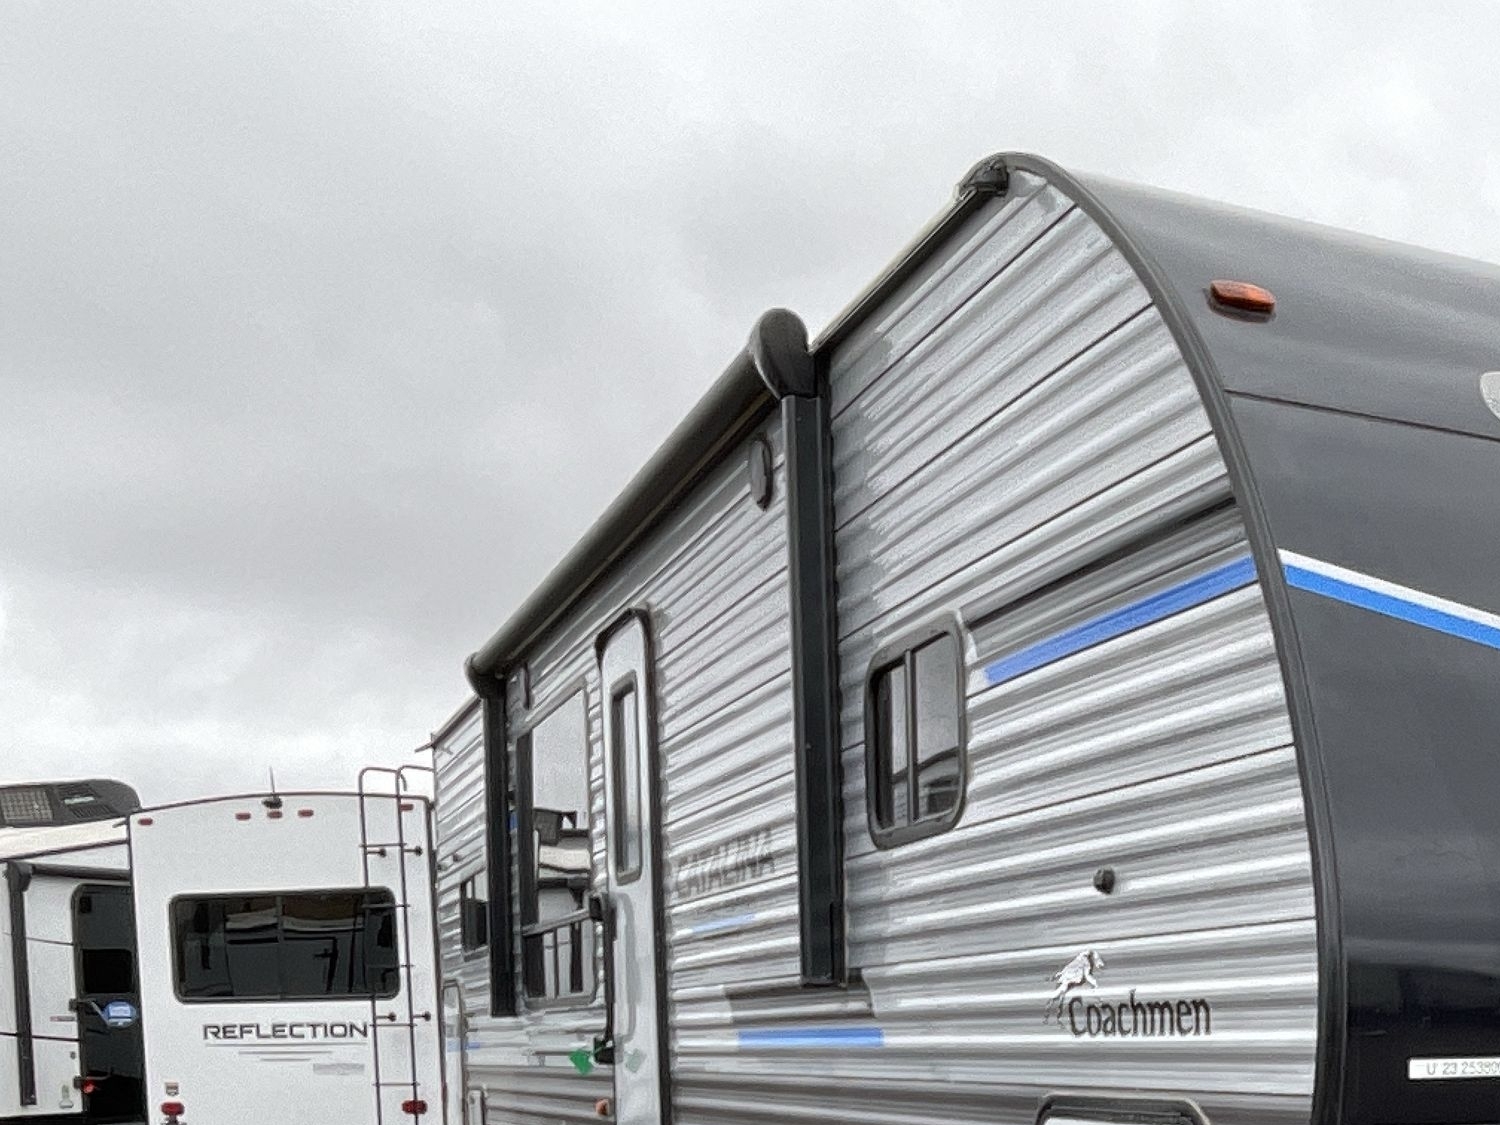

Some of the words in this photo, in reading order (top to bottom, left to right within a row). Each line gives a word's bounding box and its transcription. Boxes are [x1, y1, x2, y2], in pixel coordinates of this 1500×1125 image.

[674, 828, 776, 898] CATALINA
[202, 1022, 369, 1040] REFLECTION
[1068, 988, 1212, 1037] Coachmen
